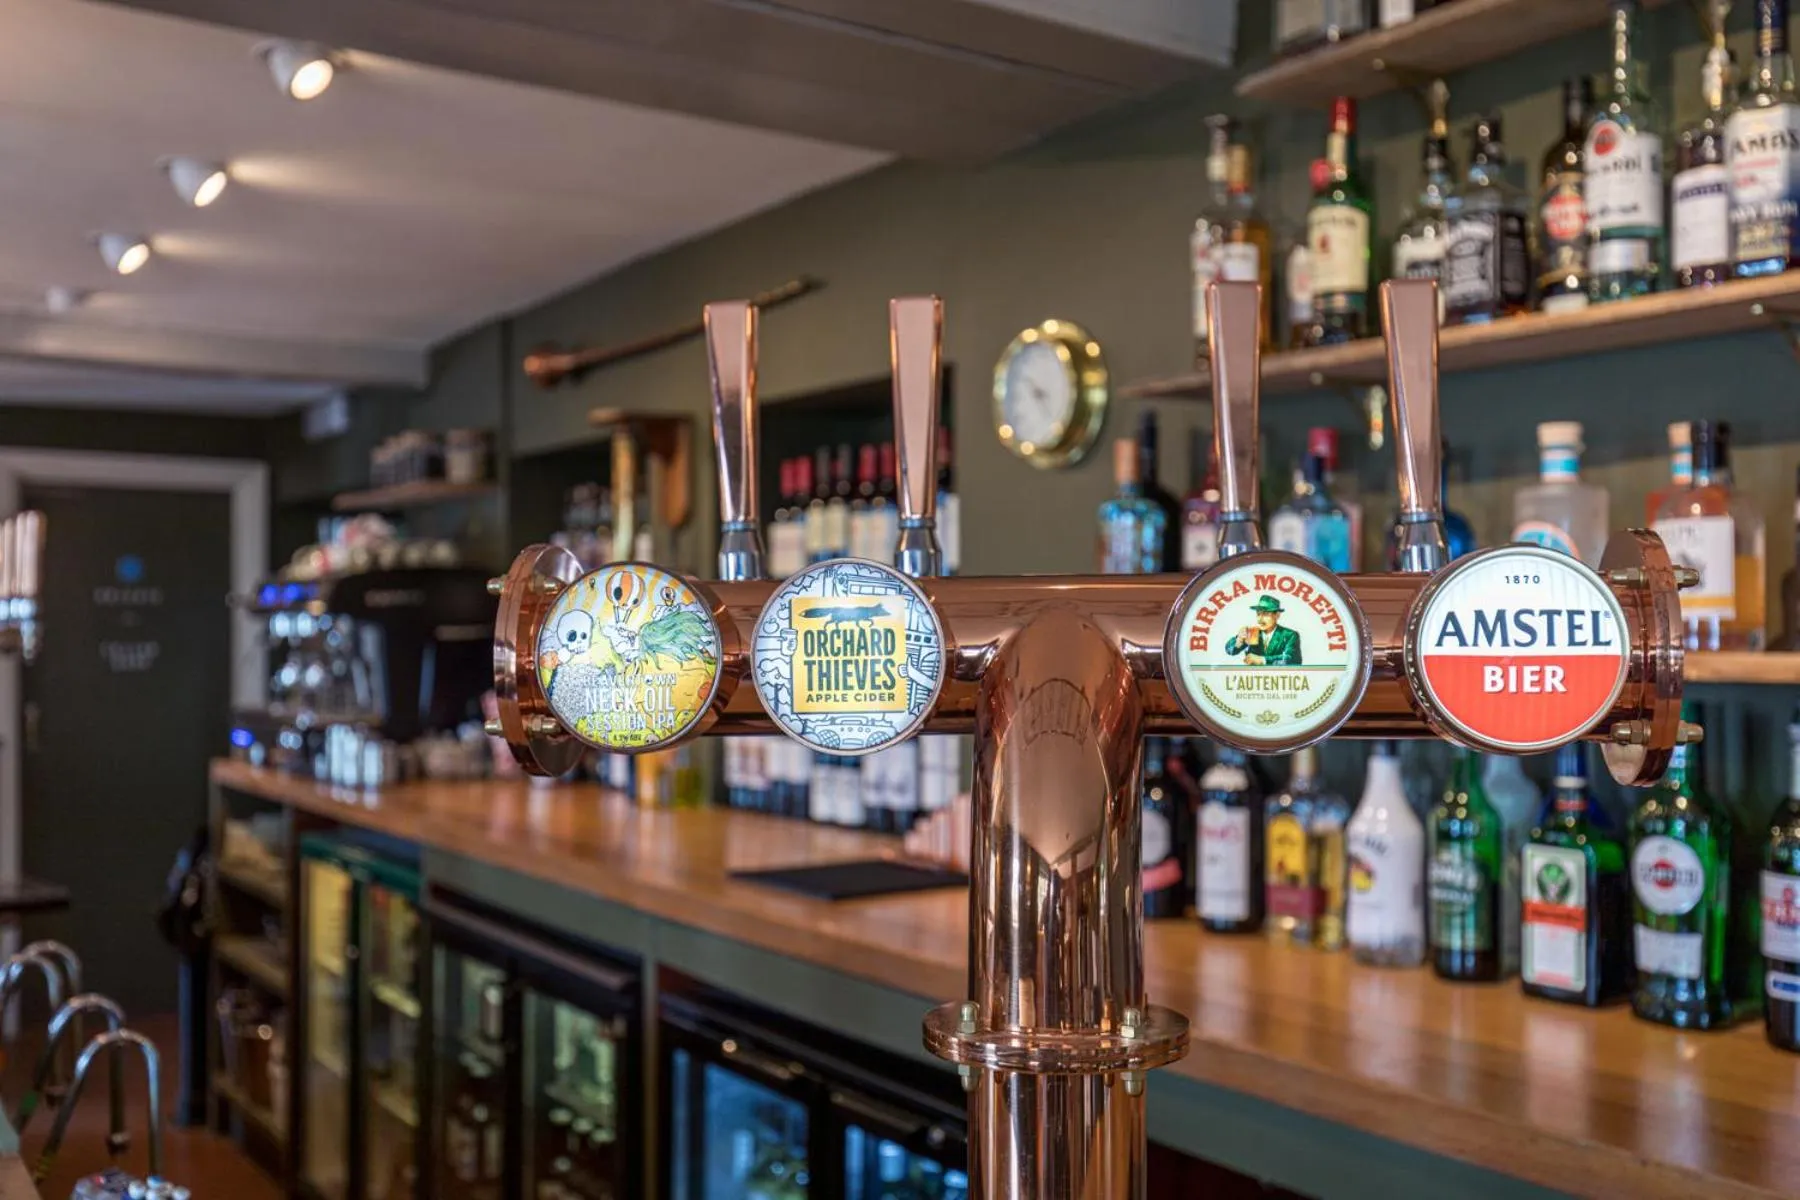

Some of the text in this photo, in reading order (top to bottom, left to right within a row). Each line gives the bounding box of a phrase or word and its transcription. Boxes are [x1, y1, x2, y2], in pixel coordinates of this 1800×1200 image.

[1505, 575, 1541, 585] 1870
[1190, 574, 1347, 651] BIRRA MORETTI
[1435, 608, 1611, 648] AMSTEL
[804, 628, 896, 657] ORCHARD
[804, 658, 896, 691] THIEVES
[1225, 675, 1310, 691] L'AUTENTICA
[1483, 665, 1567, 693] BIER
[585, 687, 675, 714] NECK OIL
[806, 692, 895, 703] APPLE CIDER
[586, 711, 675, 731] SESSION IPA
